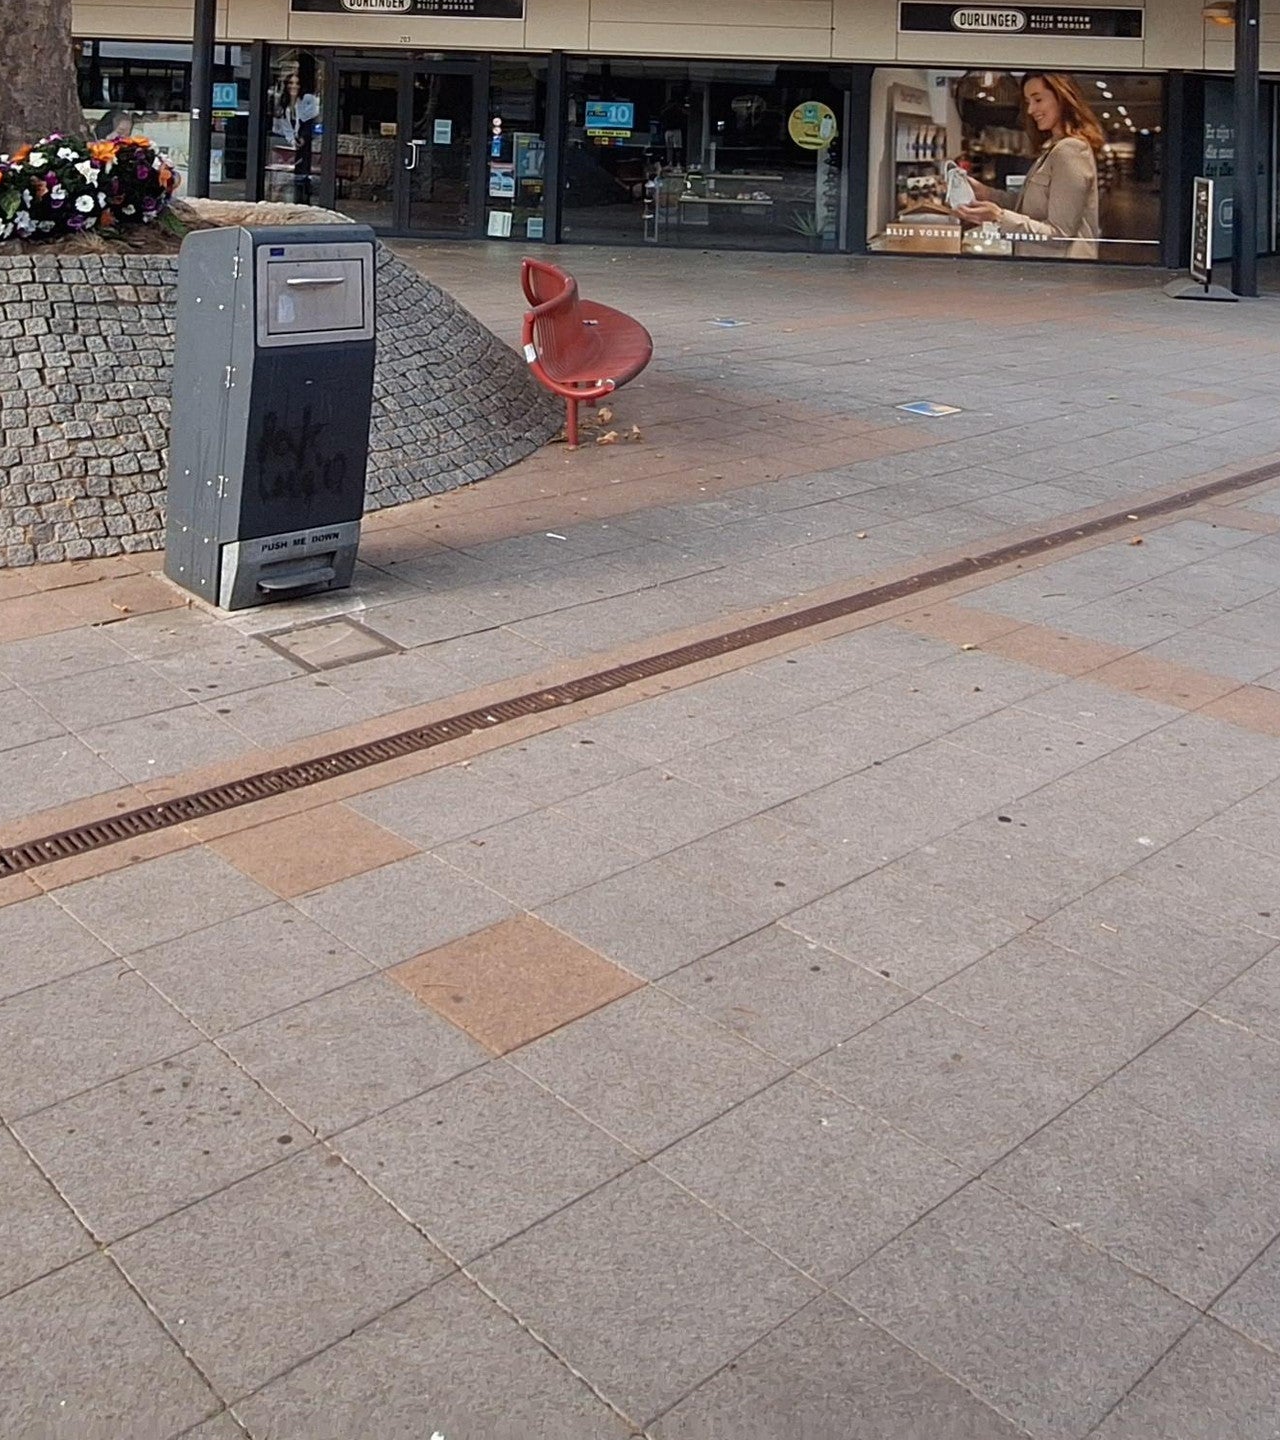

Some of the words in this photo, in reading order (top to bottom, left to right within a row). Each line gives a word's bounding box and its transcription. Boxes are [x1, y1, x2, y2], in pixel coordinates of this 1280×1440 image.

[960, 12, 1018, 27] DURLINGER
[608, 105, 629, 122] 10
[886, 227, 914, 236] BLIJE
[919, 229, 960, 238] VOETEN
[1006, 232, 1048, 241] MENSEN
[261, 541, 288, 552] PUSH
[293, 537, 306, 546] ME
[312, 532, 339, 543] DOWN
